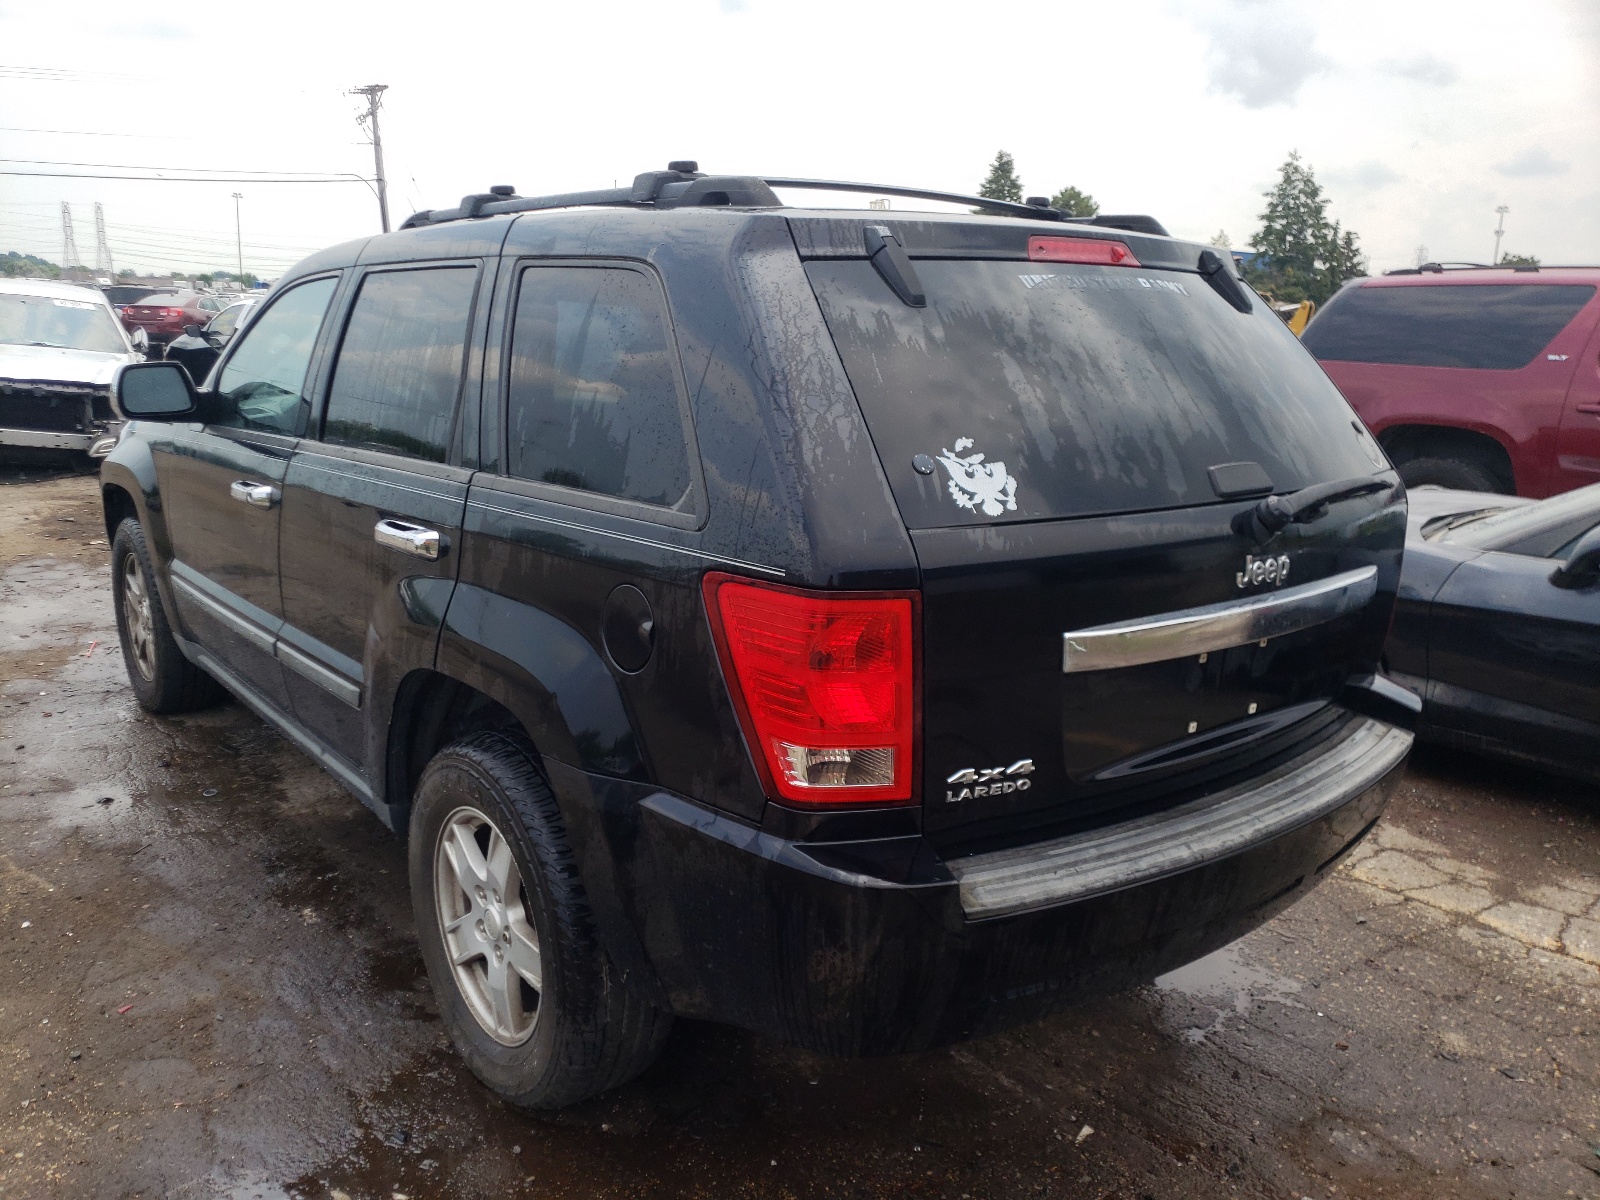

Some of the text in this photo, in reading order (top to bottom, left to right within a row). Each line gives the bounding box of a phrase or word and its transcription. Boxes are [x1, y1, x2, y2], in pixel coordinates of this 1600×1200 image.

[1236, 554, 1291, 588] Jeep
[946, 759, 1036, 784] 4x4
[946, 778, 1032, 803] LAREDO
